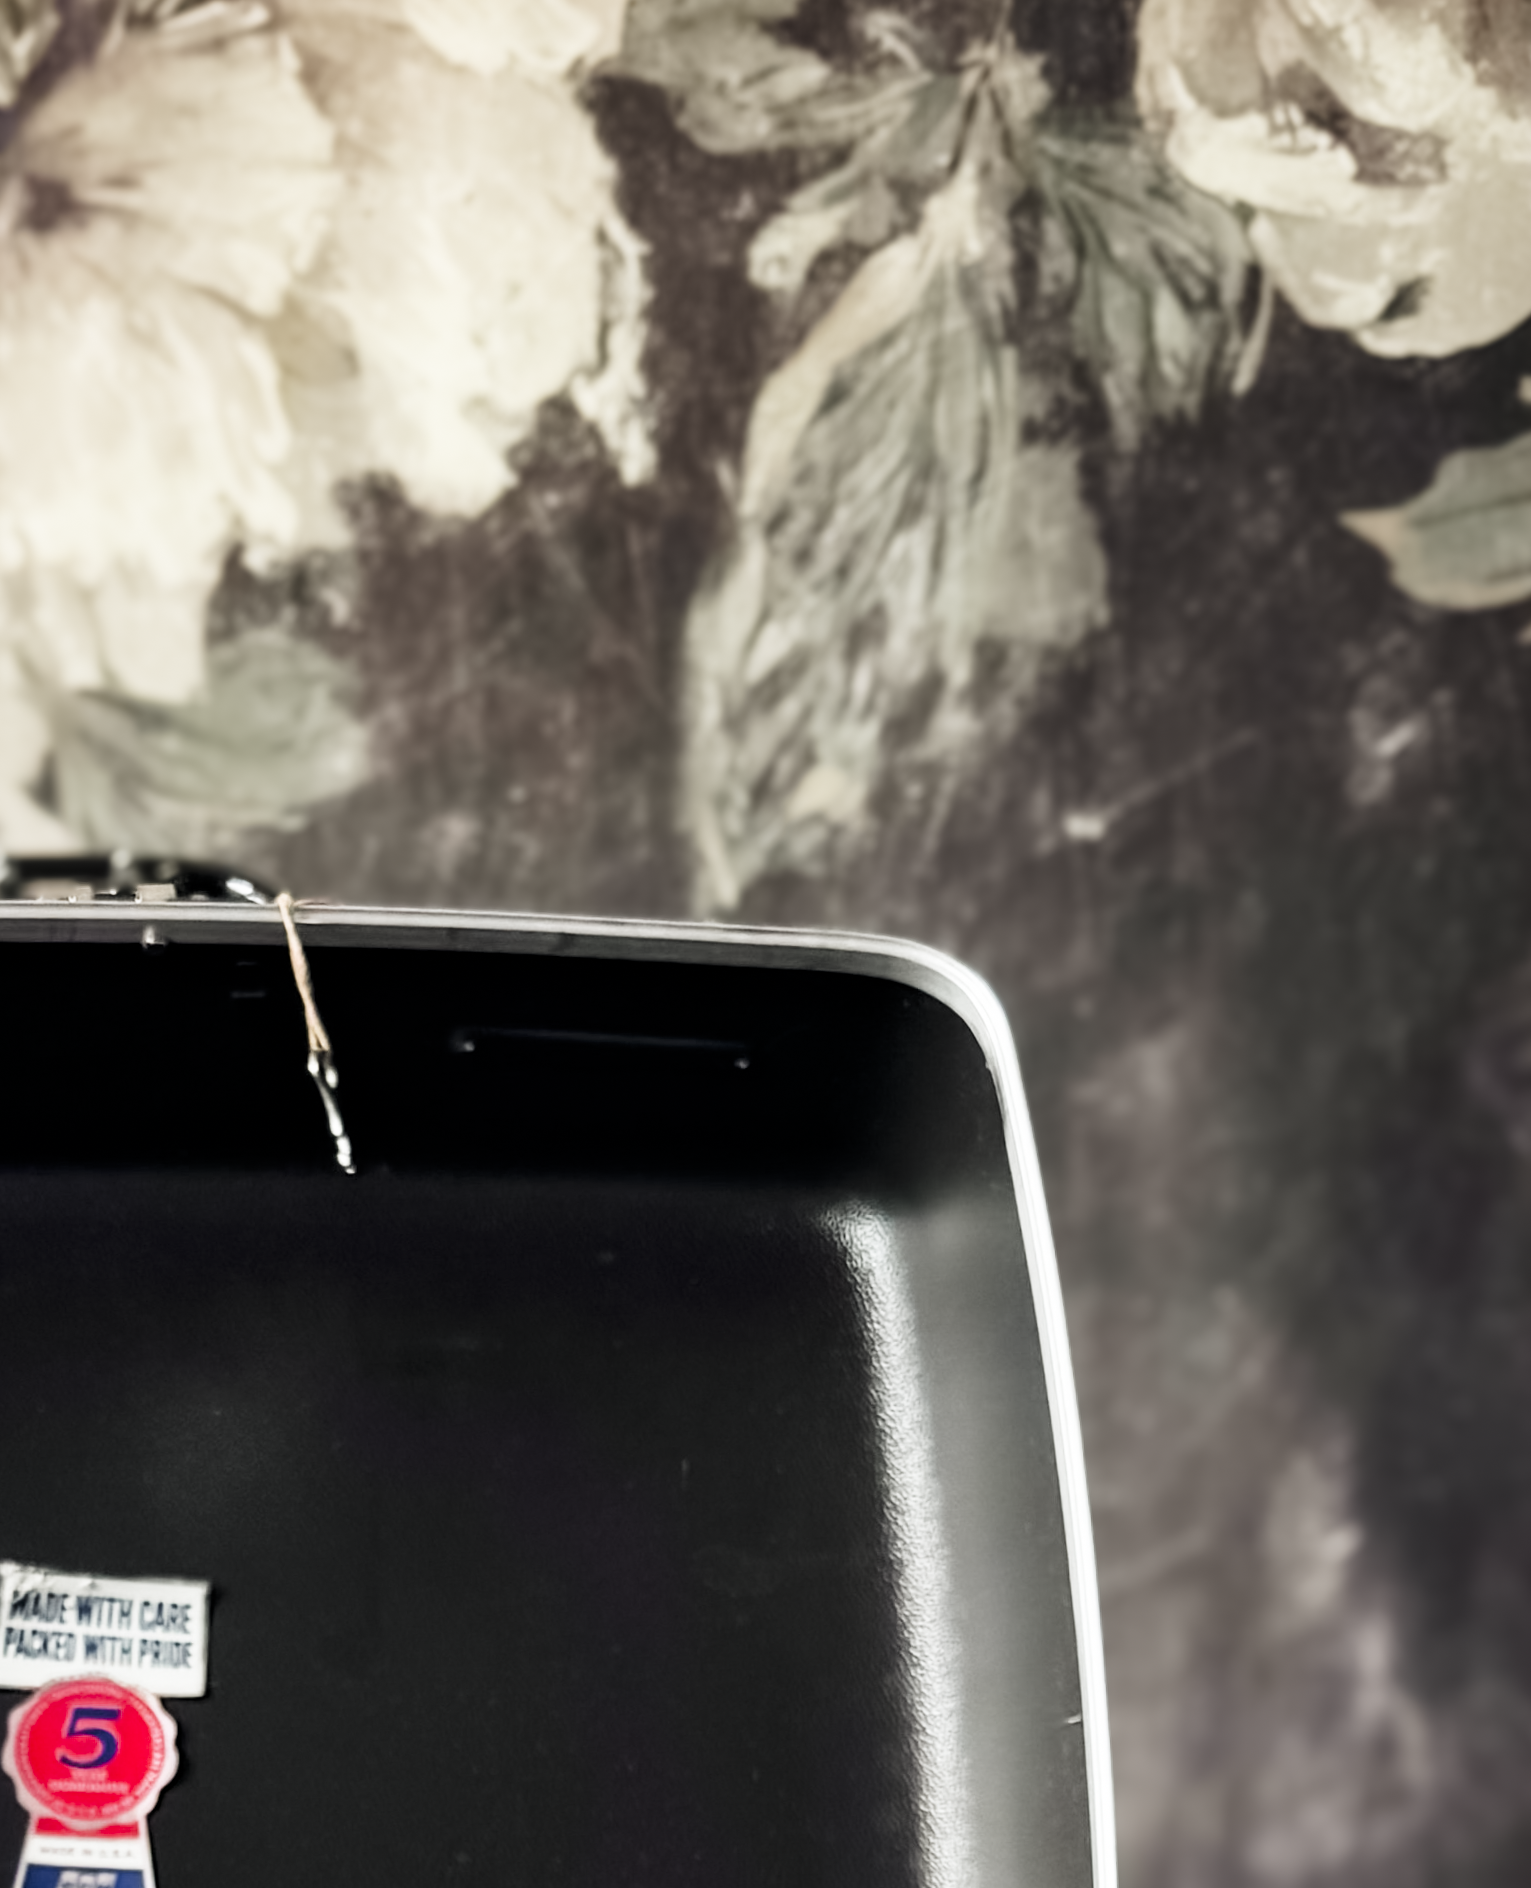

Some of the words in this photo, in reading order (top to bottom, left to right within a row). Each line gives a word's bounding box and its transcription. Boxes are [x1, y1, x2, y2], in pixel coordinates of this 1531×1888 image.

[9, 1589, 68, 1622] MADE
[76, 1595, 132, 1629] WITH
[138, 1600, 192, 1634] CARE
[3, 1627, 76, 1662] PACKED
[83, 1636, 133, 1665] WITH
[138, 1640, 192, 1669] PRIDE
[60, 1707, 120, 1768] 5
